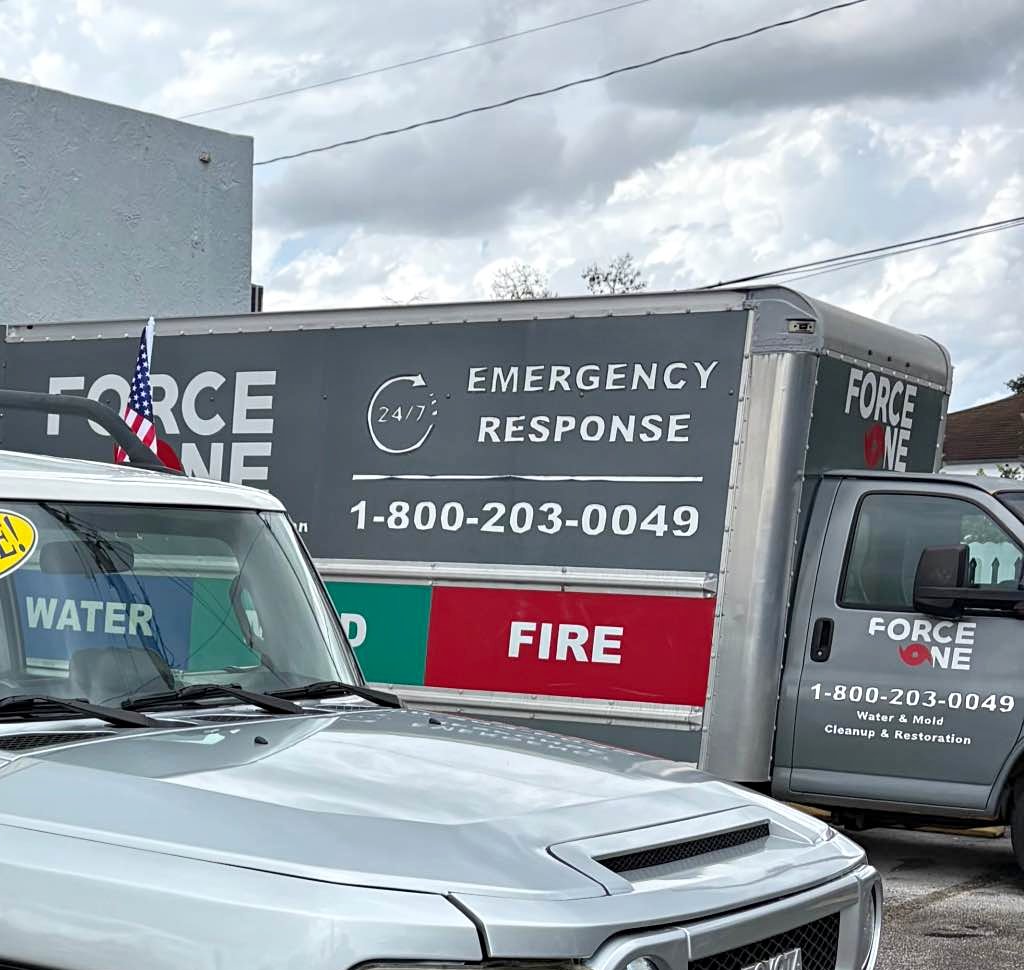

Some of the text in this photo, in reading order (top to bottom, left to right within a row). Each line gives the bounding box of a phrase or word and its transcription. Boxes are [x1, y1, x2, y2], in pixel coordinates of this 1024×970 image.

[467, 361, 719, 393] EMERGENCY
[845, 368, 917, 429] FORCE
[377, 405, 426, 424] 24/7
[477, 413, 691, 443] RESPONSE
[350, 500, 700, 537] 1-800-203-0049
[26, 596, 154, 636] WATER
[868, 617, 976, 645] FORCE
[508, 621, 624, 664] FIRE
[810, 683, 1015, 713] 1-800-203-0049
[856, 710, 944, 726] Water & Mold
[824, 724, 972, 745] Cleanup & Restoration
